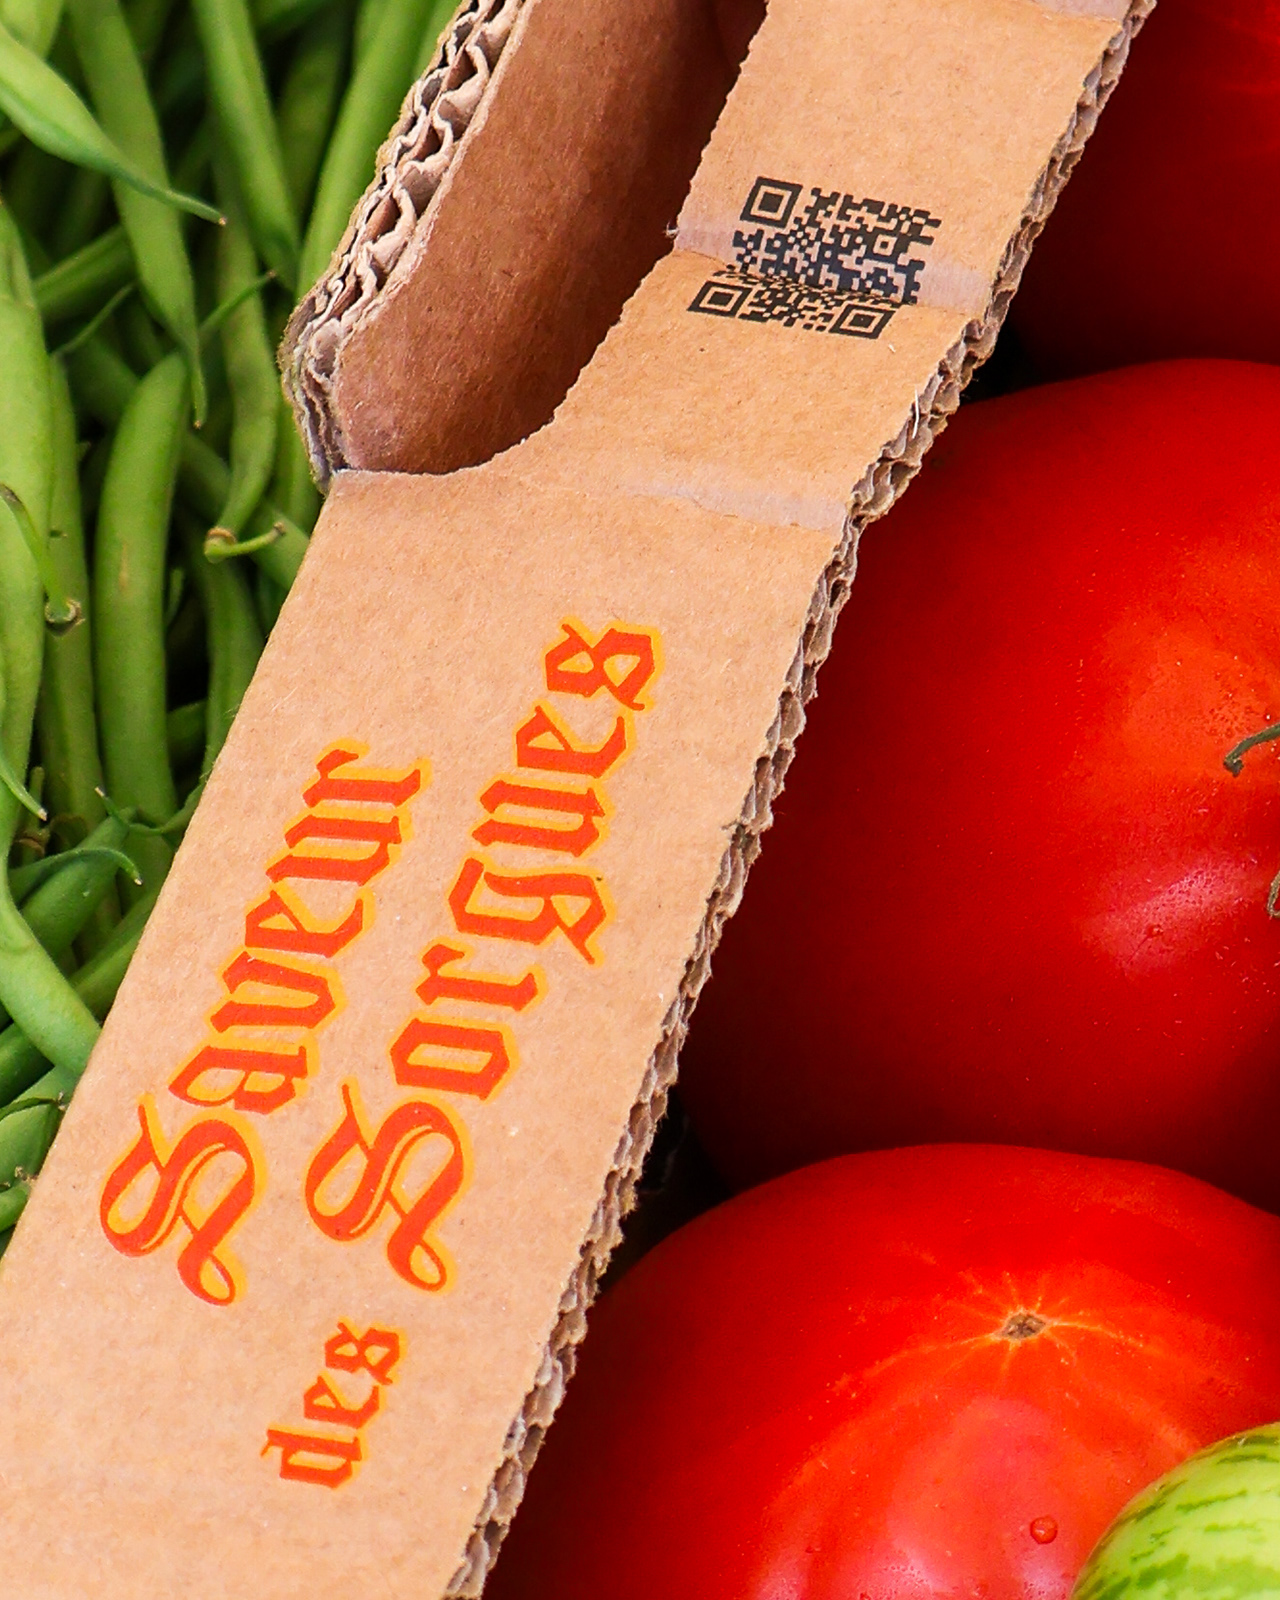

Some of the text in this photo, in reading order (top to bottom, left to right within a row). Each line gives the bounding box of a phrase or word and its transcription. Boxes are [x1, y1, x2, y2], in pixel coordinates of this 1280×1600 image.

[99, 738, 433, 1307] Saveur
[261, 615, 662, 1490] des Sorgues
